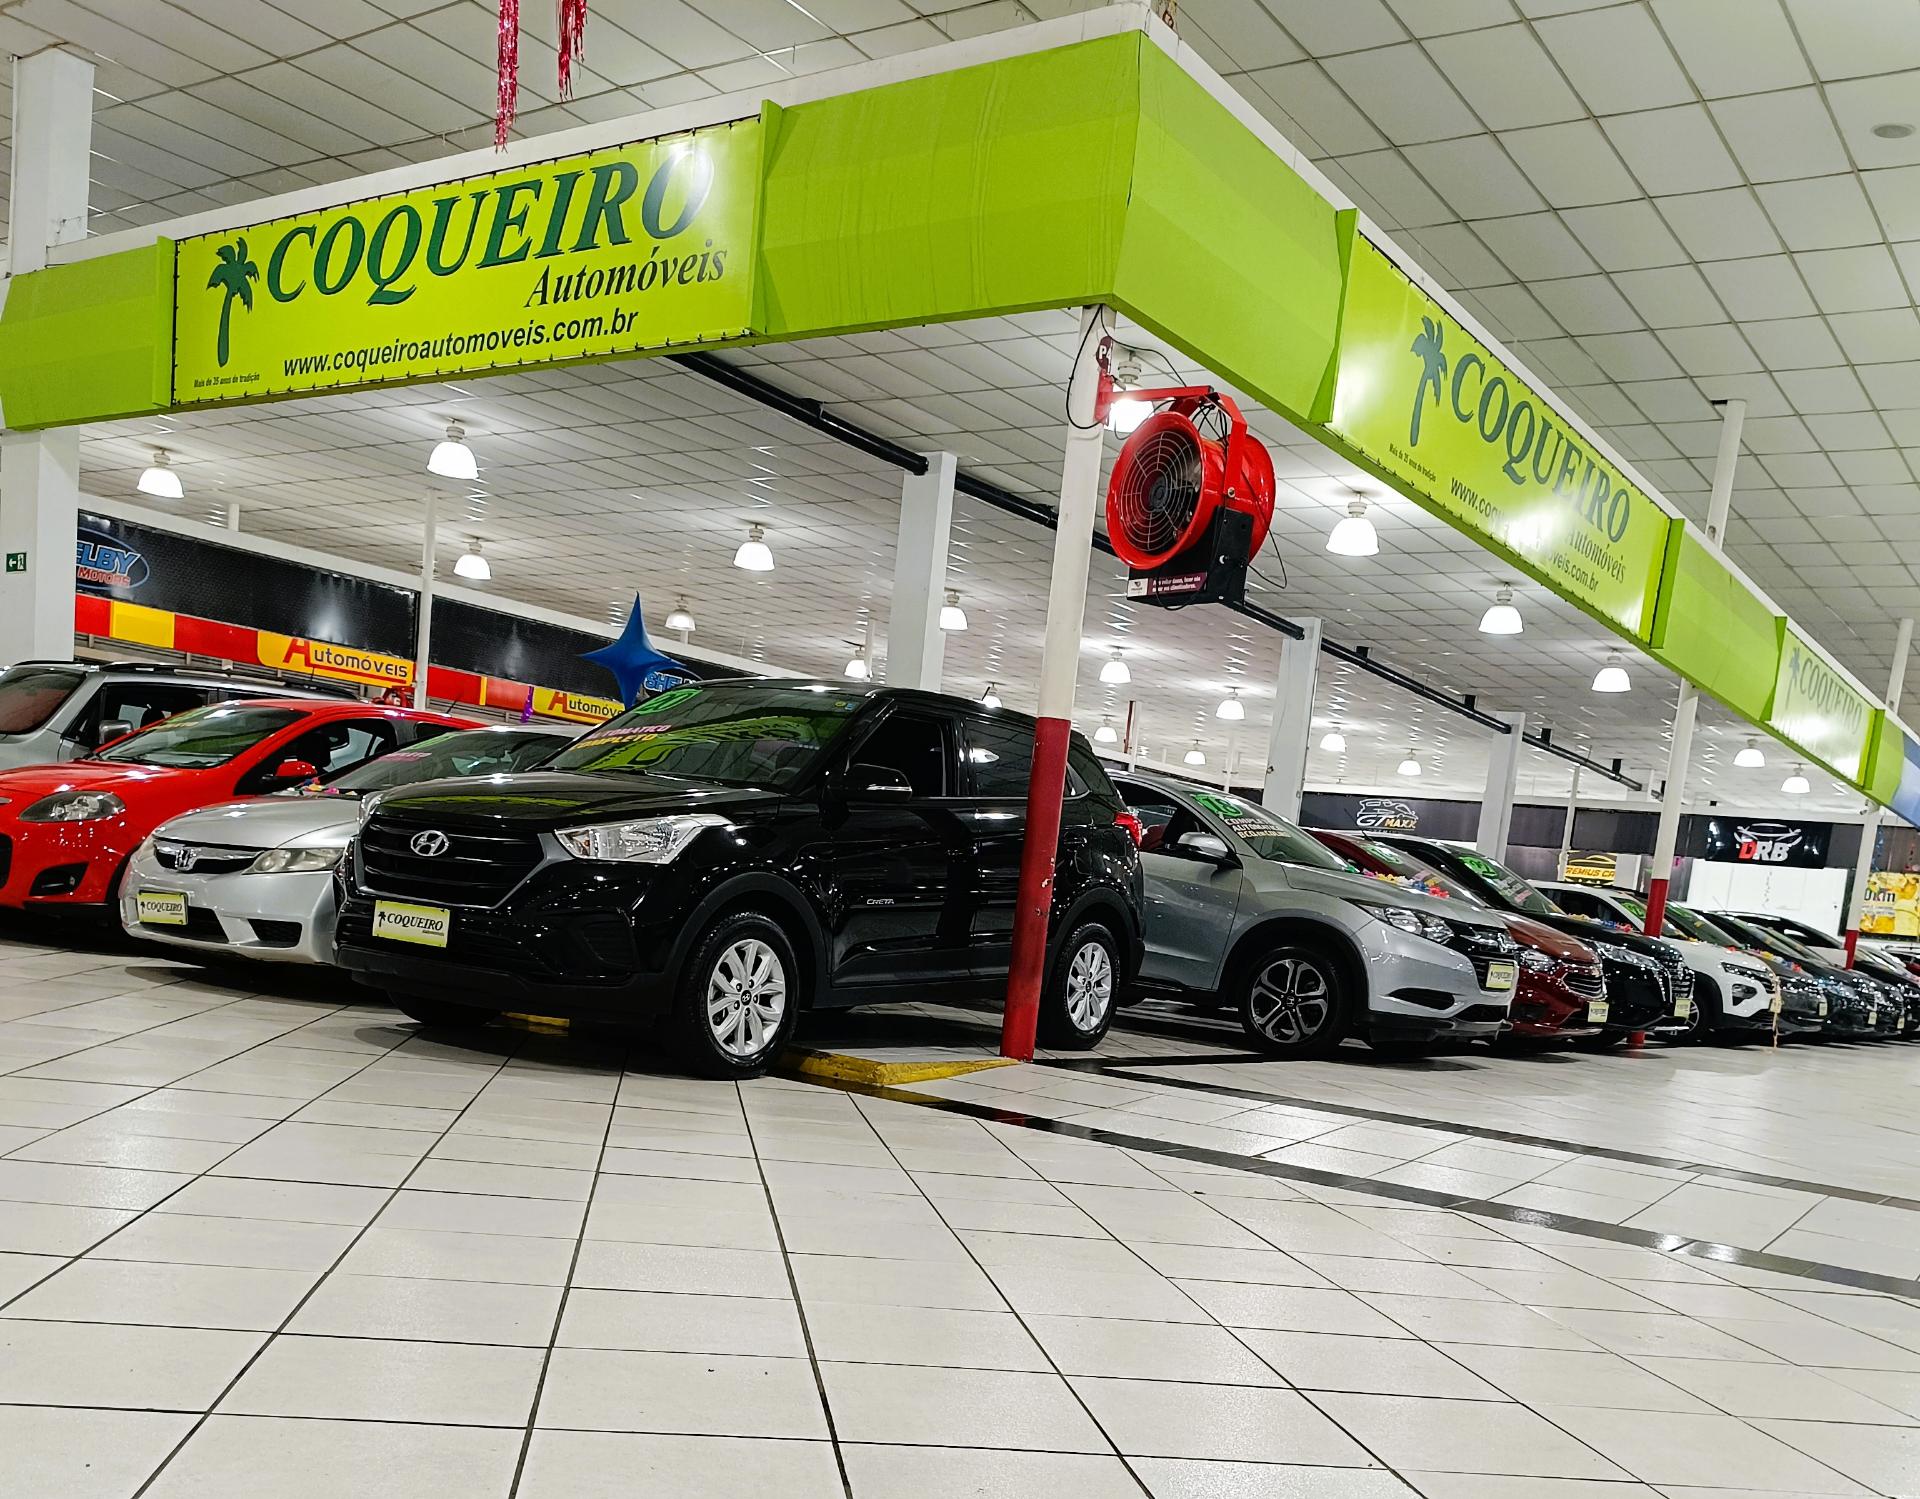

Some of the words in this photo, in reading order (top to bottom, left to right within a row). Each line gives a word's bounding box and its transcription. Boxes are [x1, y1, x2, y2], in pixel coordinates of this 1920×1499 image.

[267, 148, 714, 306] COQUEIRO
[525, 239, 727, 308] Automóveis
[284, 309, 639, 376] www.coqueiroautomoveis.com.br
[1451, 353, 1630, 543] COQUEIRO
[1738, 840, 1790, 862] DRB
[146, 901, 182, 913] COQUEIRO
[387, 913, 444, 931] COQUEIRO
